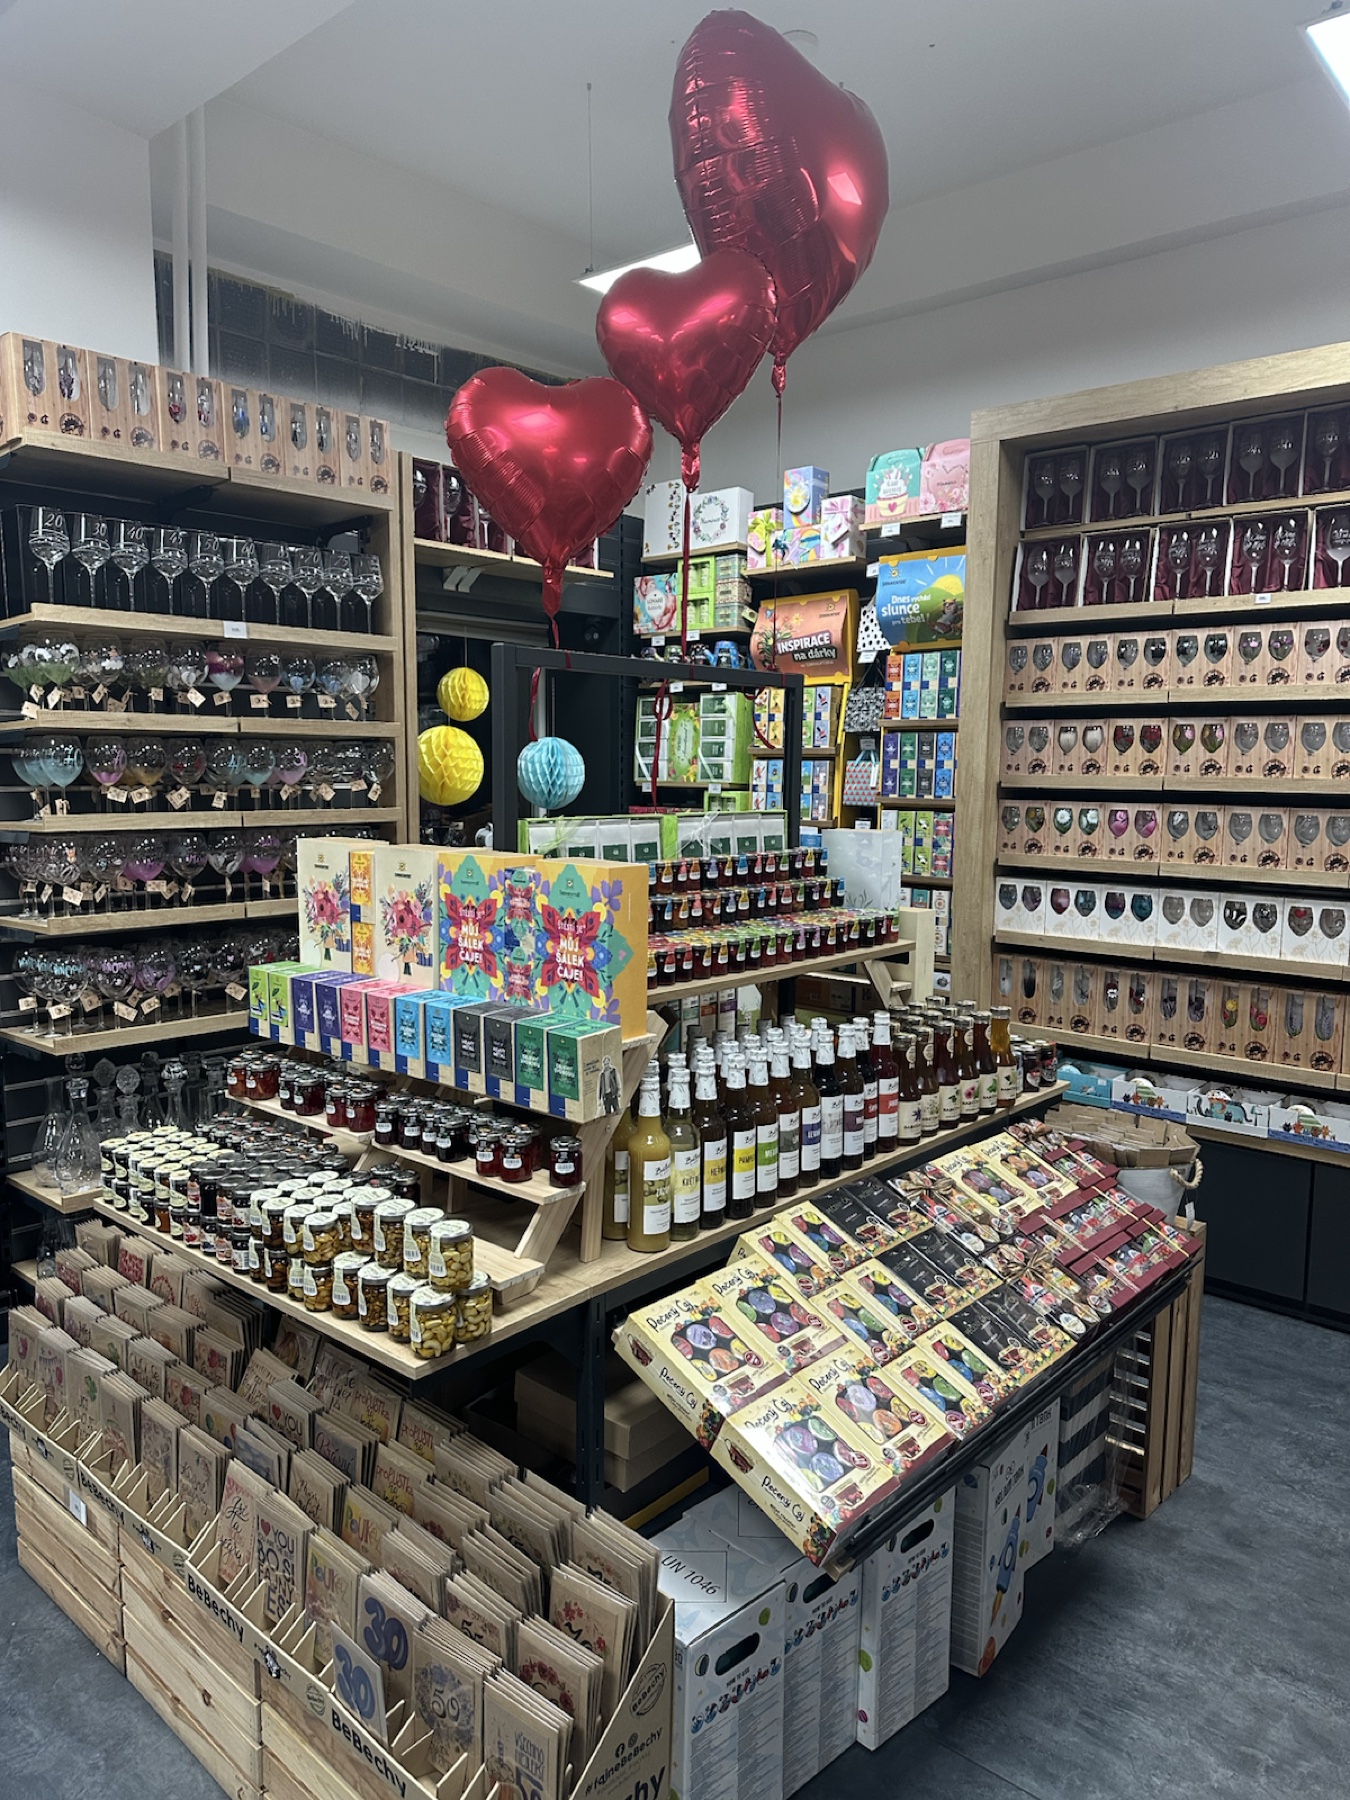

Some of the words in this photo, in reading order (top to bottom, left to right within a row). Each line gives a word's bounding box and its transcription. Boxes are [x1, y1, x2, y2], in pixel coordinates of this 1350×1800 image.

[44, 513, 64, 528] 20
[92, 522, 108, 537] 30
[126, 526, 144, 540] 40
[205, 536, 220, 551] 50
[241, 541, 255, 555] 60
[304, 551, 319, 564] 70
[333, 555, 348, 567] 75
[891, 594, 910, 605] Dnes
[881, 603, 920, 617] slunce
[776, 632, 832, 655] INSPIRACE
[793, 652, 807, 662] na
[807, 647, 837, 660] dárky
[461, 918, 480, 937] MŮJ
[457, 934, 485, 951] ŠÁLEK
[559, 933, 580, 952] MŮJ
[459, 950, 483, 964] ČAJE!
[555, 951, 585, 968] ŠÁLEK
[556, 965, 583, 982] ČAJE!
[284, 1409, 303, 1436] YOU
[271, 1526, 295, 1555] YOU
[660, 1555, 684, 1575] UN
[684, 1568, 721, 1596] 1046
[187, 1571, 245, 1644] BeBechy
[363, 1596, 409, 1671] 30
[334, 1643, 376, 1720] 30
[631, 1667, 665, 1713] BeBechy
[331, 1708, 407, 1799] BeBechy
